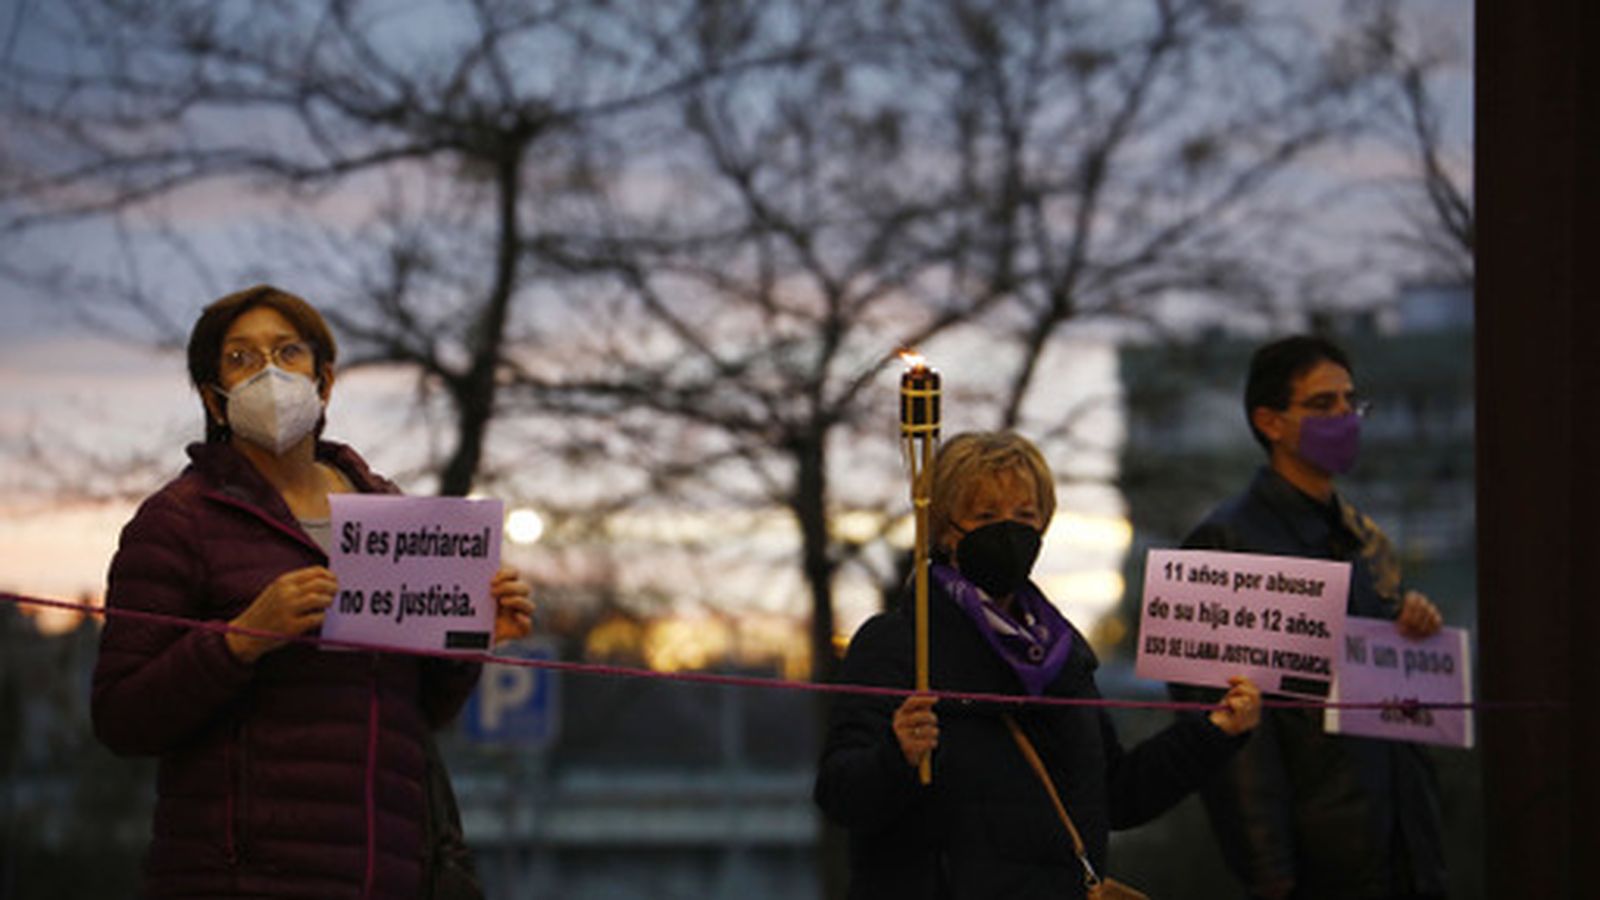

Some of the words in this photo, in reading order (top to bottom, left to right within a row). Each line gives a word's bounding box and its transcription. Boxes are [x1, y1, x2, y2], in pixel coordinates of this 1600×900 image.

[341, 521, 361, 554] Si
[366, 530, 390, 555] es
[394, 524, 491, 563] patriarcal
[1164, 562, 1182, 581] 11
[1188, 564, 1229, 586] años
[1233, 571, 1261, 592] por
[1266, 572, 1325, 597] abusar
[340, 589, 364, 614] no
[369, 589, 393, 615] es
[395, 584, 476, 623] justicia.
[1147, 597, 1169, 619] de
[1174, 603, 1194, 621] su
[1198, 601, 1229, 629] hija
[1234, 606, 1256, 629] de
[1261, 609, 1282, 632] 12
[1285, 612, 1332, 639] años.
[1145, 635, 1166, 655] ESO
[1168, 637, 1183, 657] SE
[1184, 640, 1220, 661] LLAMA
[1221, 643, 1269, 667] JUSTICIA
[1345, 634, 1367, 665] Ni
[1372, 645, 1398, 668] un
[1403, 648, 1455, 678] paso
[480, 661, 533, 730] P
